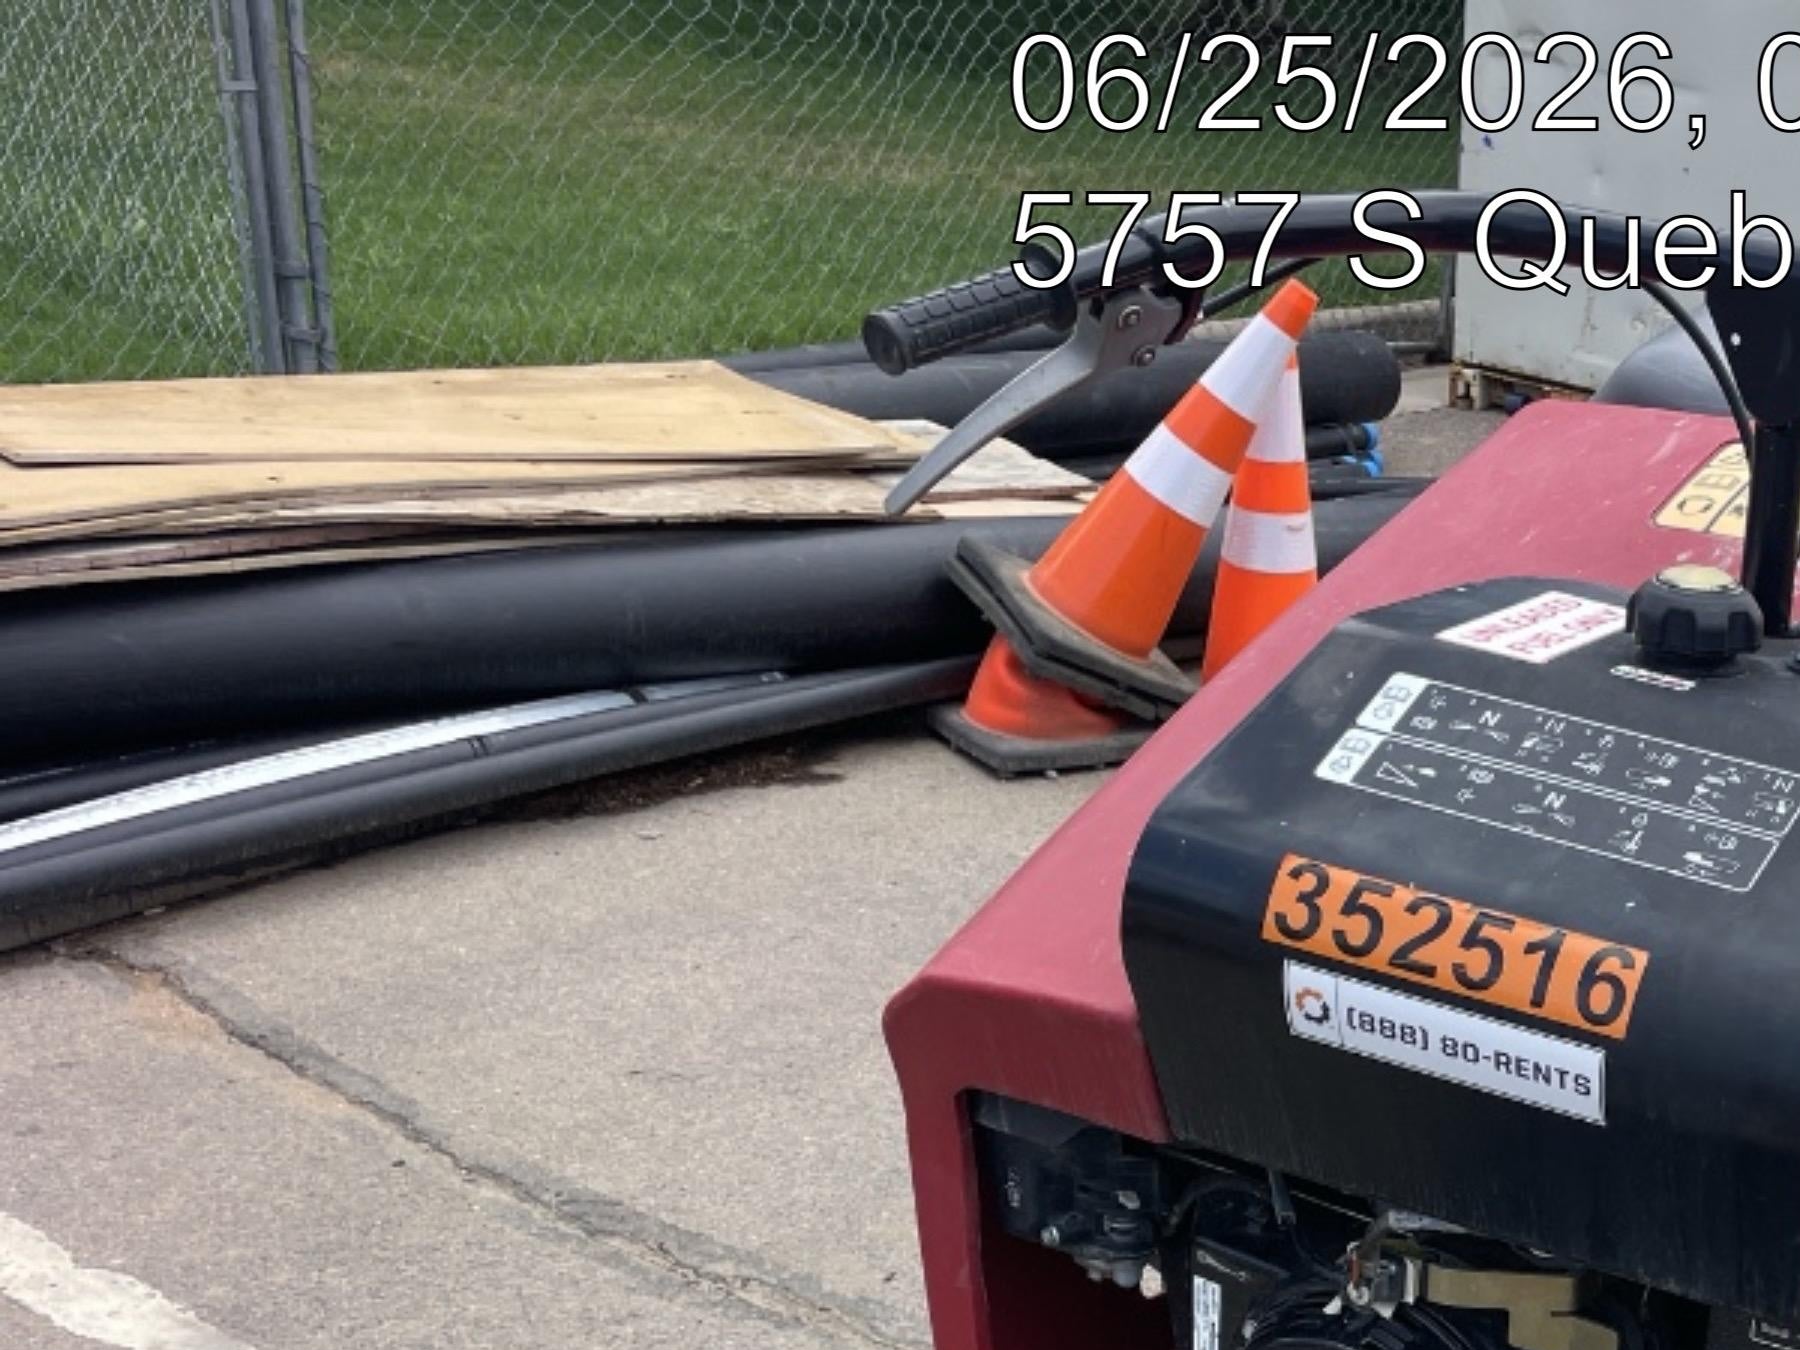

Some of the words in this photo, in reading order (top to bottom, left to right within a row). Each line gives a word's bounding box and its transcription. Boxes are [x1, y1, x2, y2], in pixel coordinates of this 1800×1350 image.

[1273, 862, 1636, 1027] 352516
[1346, 1006, 1430, 1051] (888)
[1440, 1032, 1592, 1097] 80-RENTS
